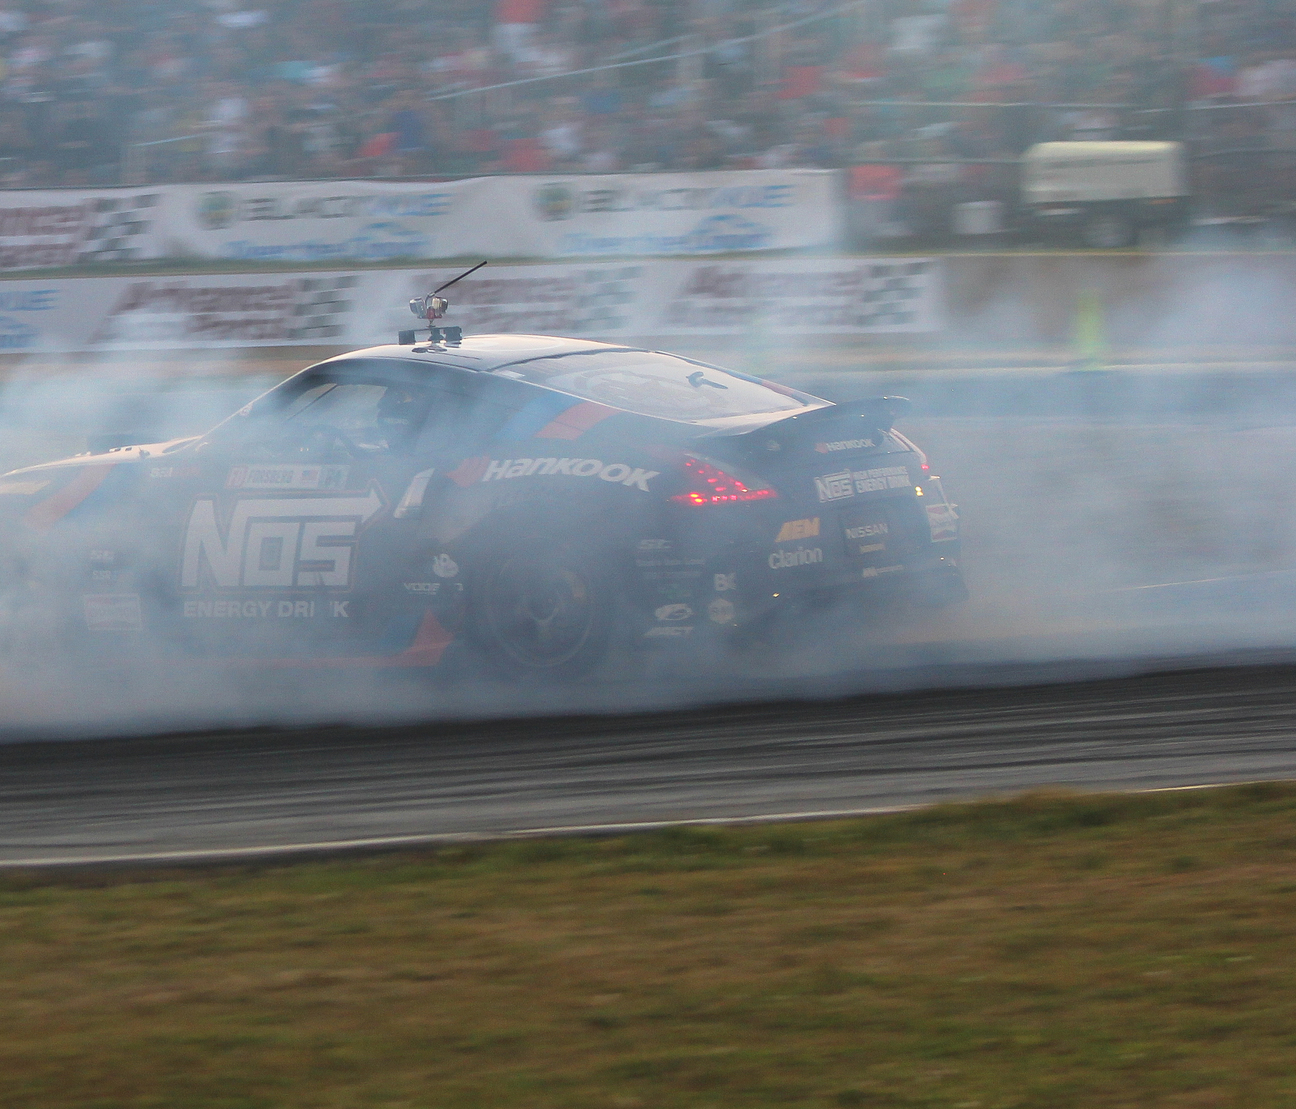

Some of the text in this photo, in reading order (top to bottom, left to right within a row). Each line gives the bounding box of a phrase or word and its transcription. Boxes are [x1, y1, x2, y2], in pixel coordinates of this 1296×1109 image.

[814, 468, 854, 503] NOS
[180, 493, 388, 588] NOS
[846, 523, 888, 539] NISSAN
[768, 546, 823, 569] clarion
[184, 601, 349, 618] ENERGY DRIK
